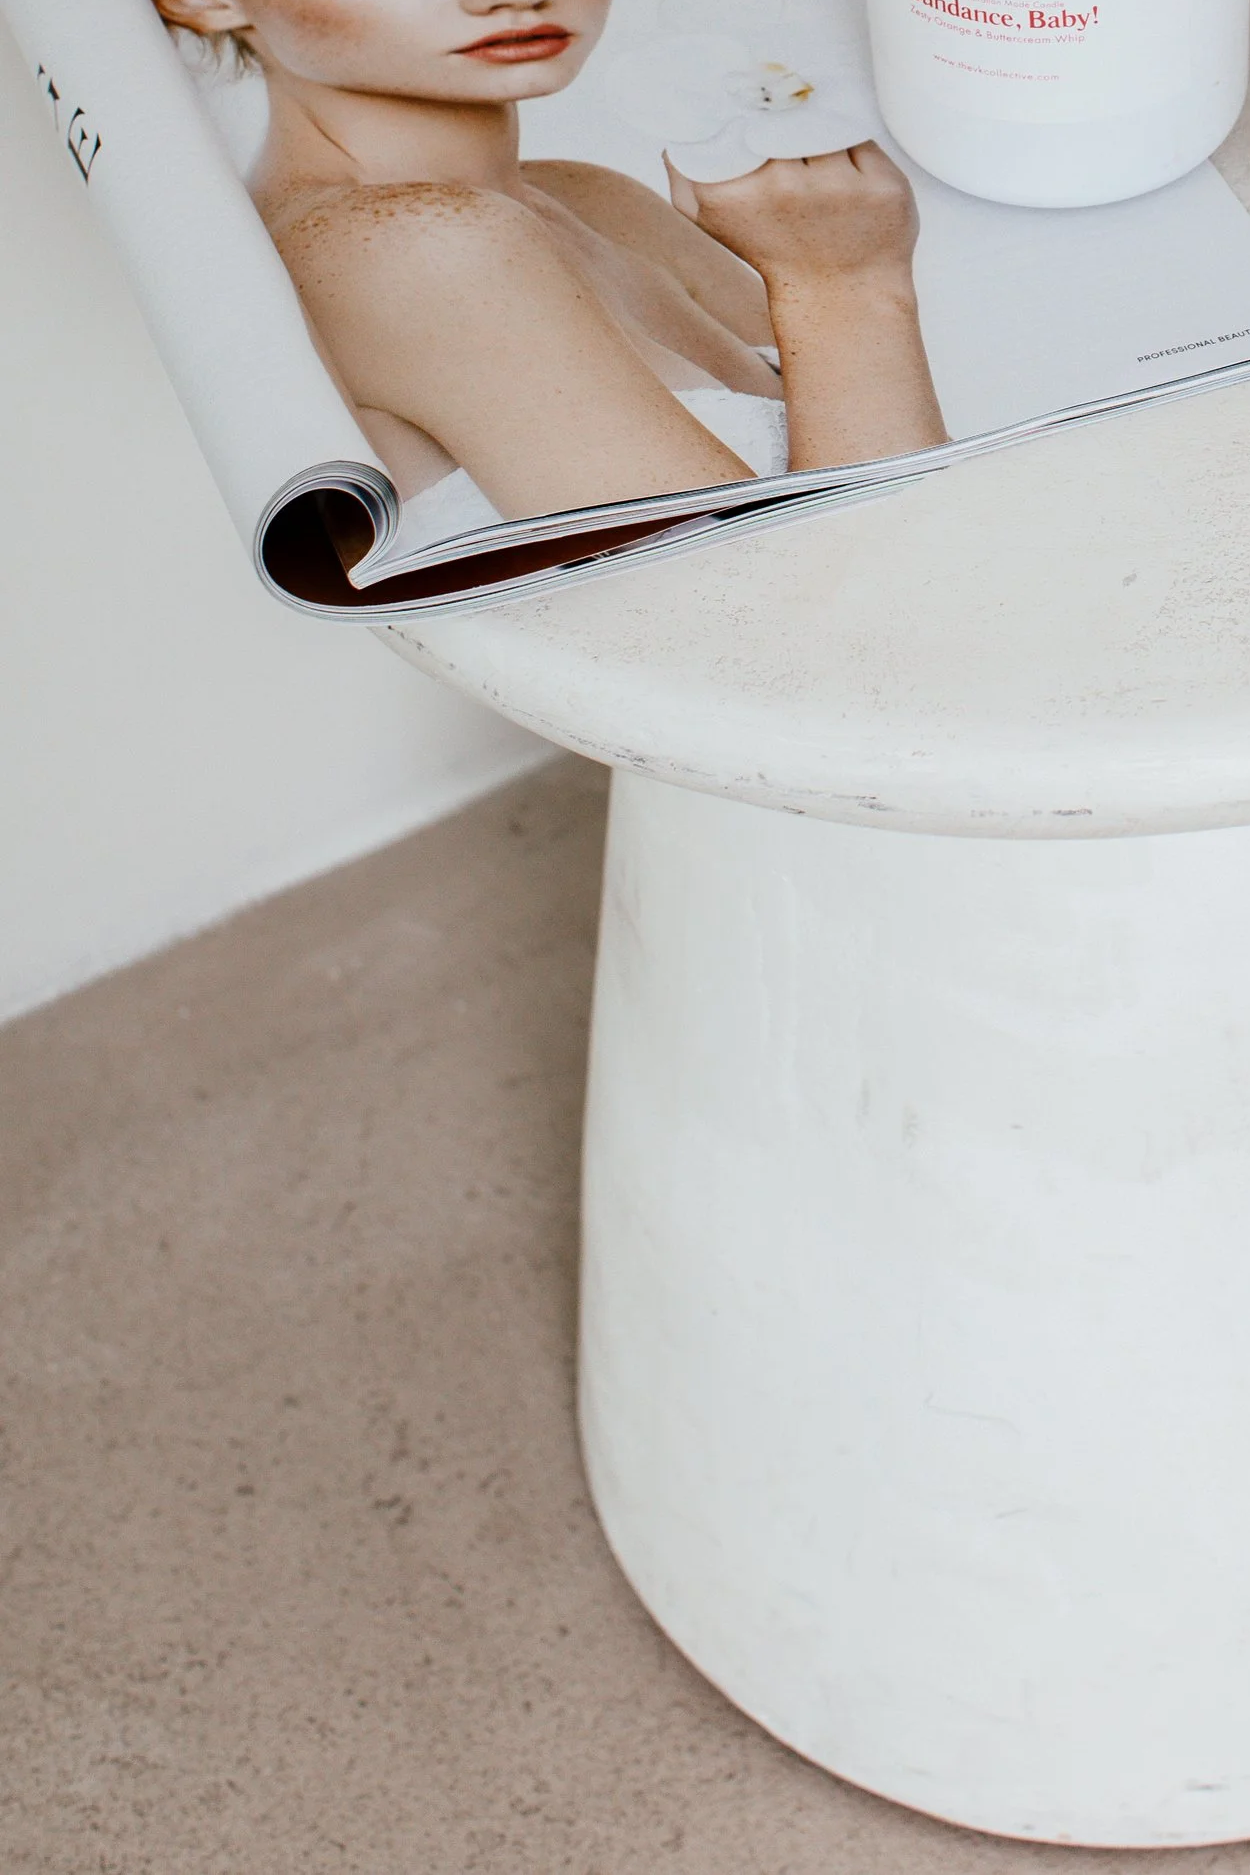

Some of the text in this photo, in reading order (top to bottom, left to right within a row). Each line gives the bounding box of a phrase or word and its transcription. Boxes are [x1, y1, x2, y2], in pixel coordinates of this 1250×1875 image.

[1004, 0, 1030, 9] Made
[1032, 0, 1065, 9] Candle
[910, 5, 1085, 44] Zesty Orange & Buttercream Whip
[1028, 5, 1099, 31] Baby!
[1137, 339, 1216, 363] PROFESSIONAL
